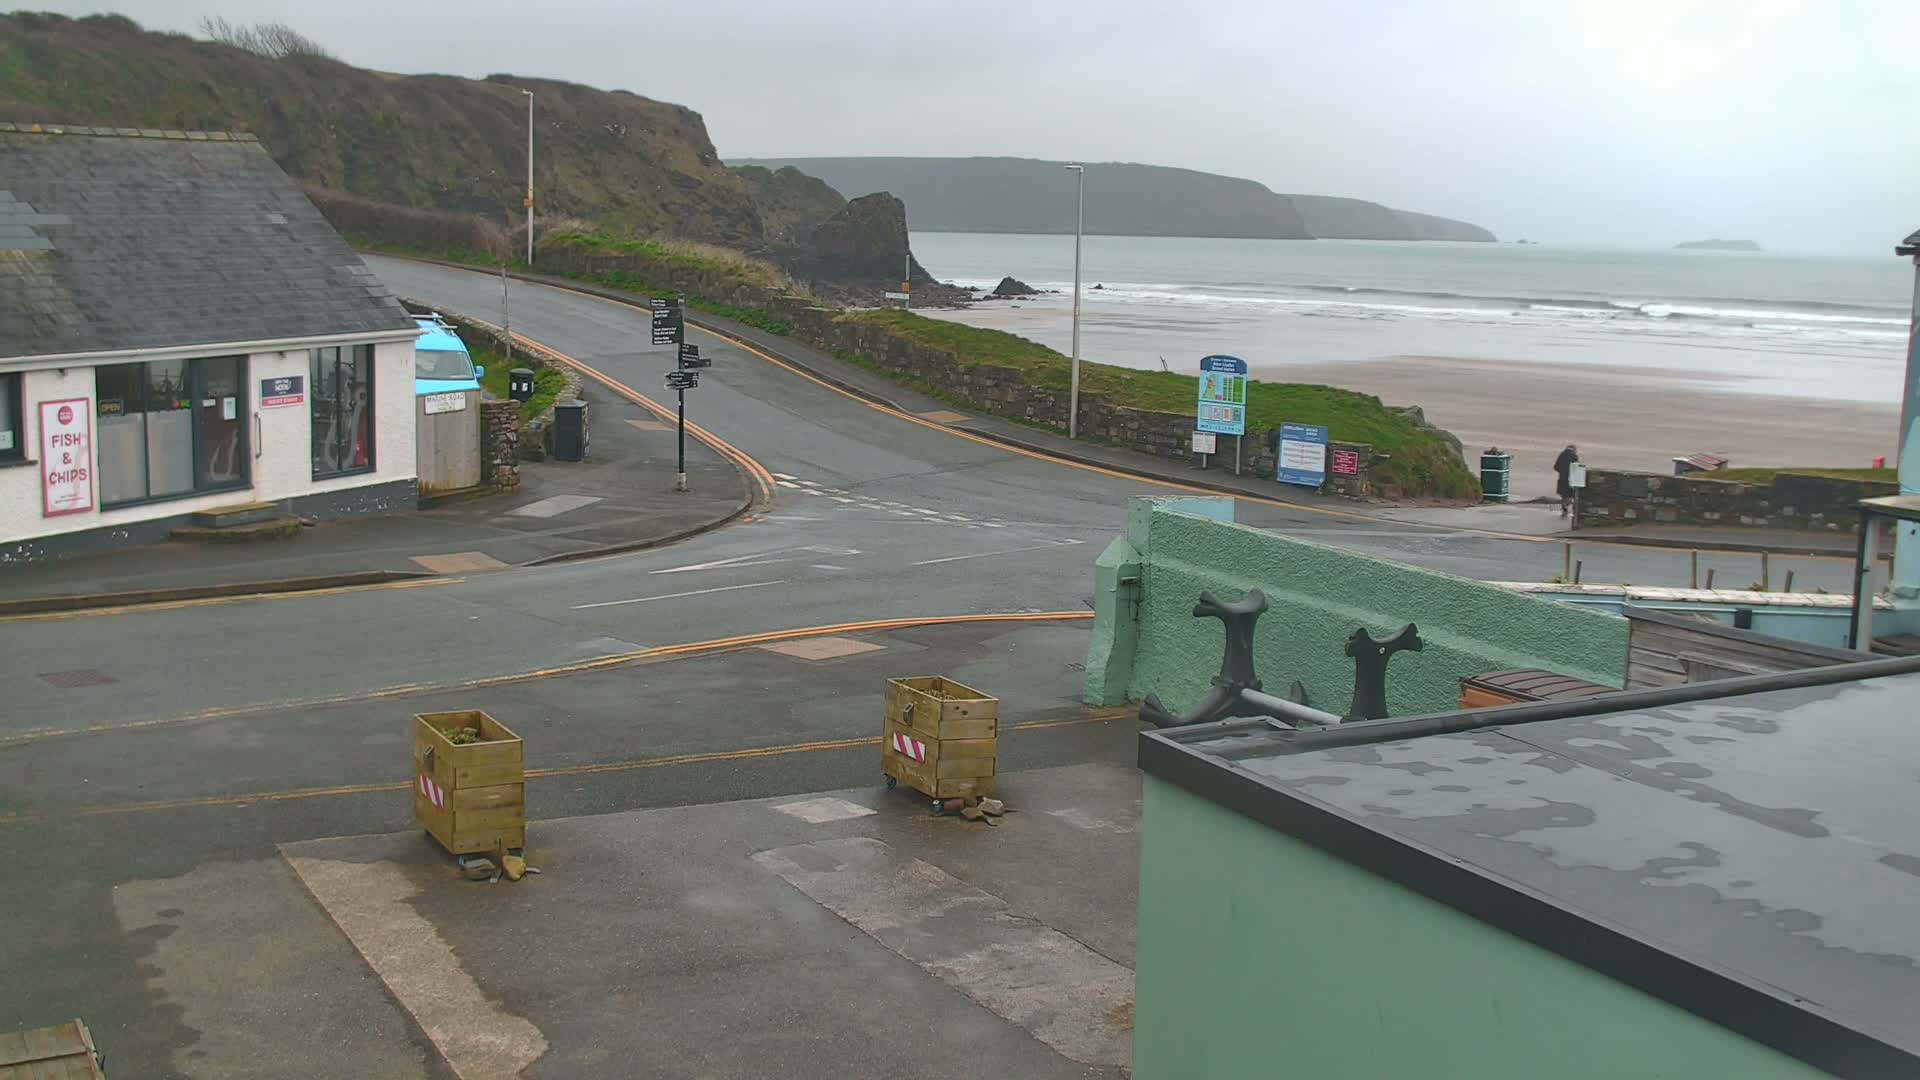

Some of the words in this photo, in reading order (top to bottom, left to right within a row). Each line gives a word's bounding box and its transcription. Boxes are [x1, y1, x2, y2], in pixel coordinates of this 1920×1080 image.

[51, 432, 81, 449] FISH
[62, 452, 72, 465] &
[48, 468, 89, 485] CHIPS
